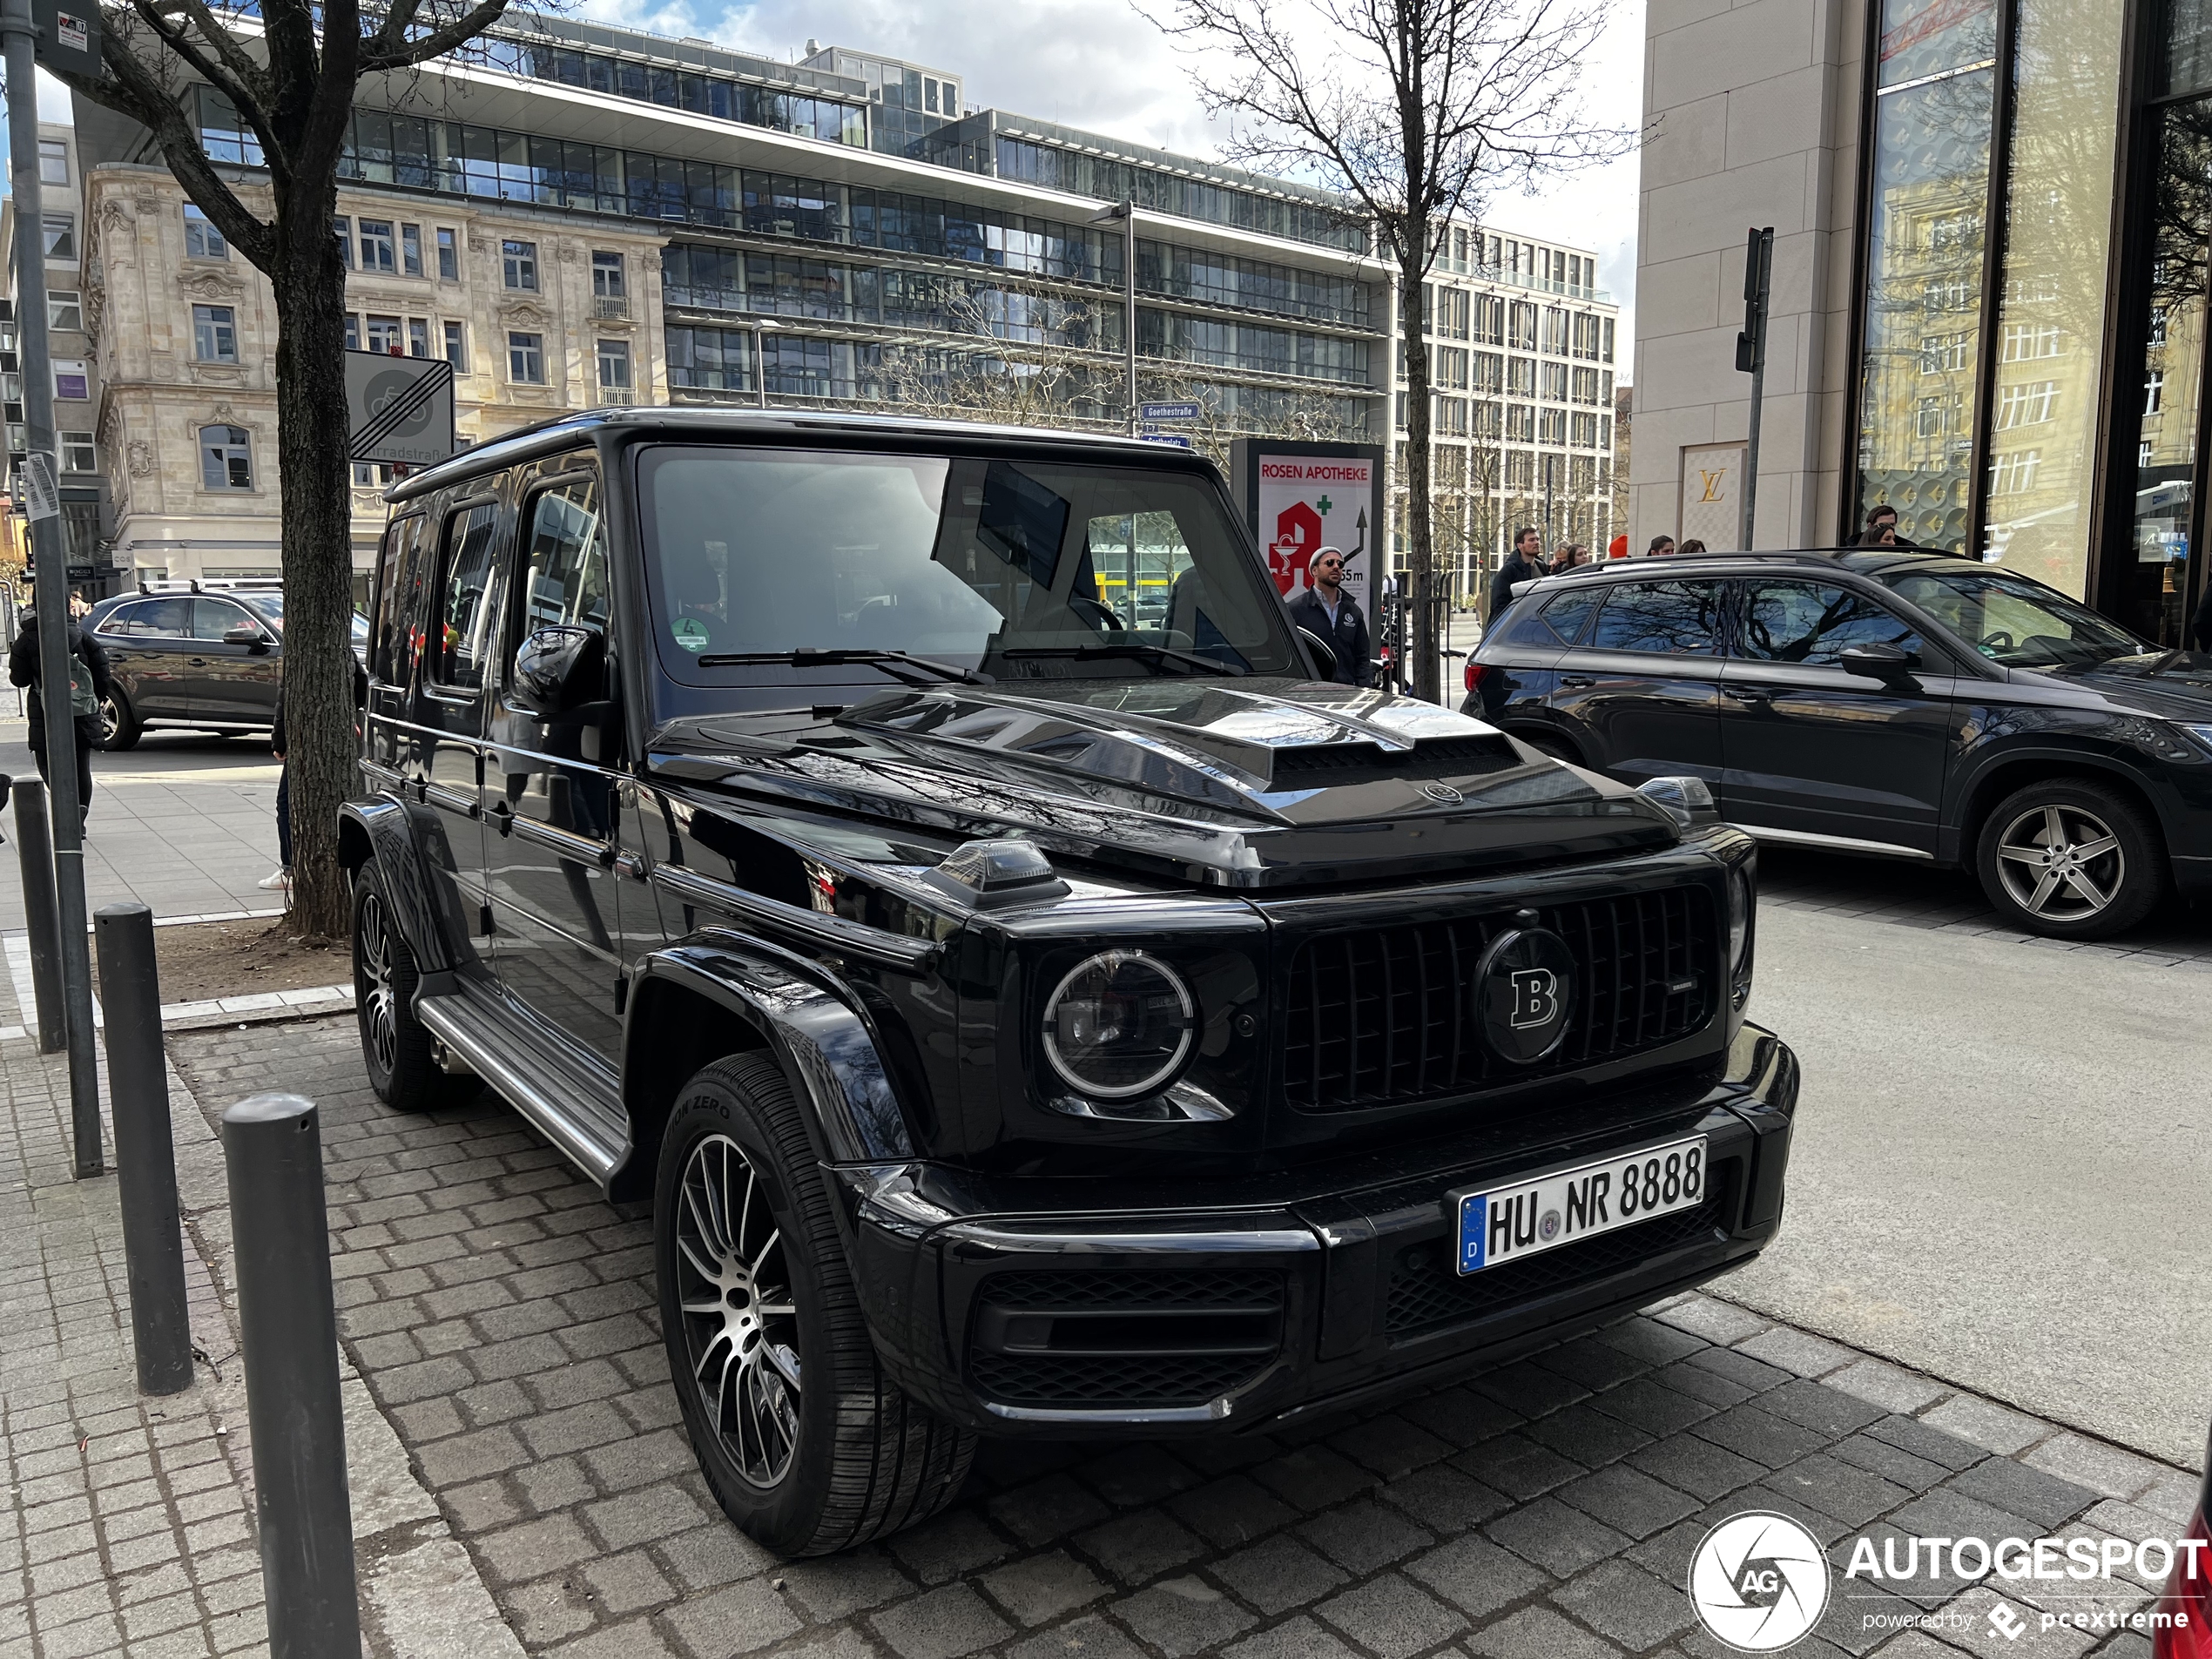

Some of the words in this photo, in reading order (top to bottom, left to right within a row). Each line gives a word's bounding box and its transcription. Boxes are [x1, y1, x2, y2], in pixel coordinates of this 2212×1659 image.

[1149, 406, 1192, 416] Goethestraße
[1262, 464, 1303, 479] ROSEN
[1306, 466, 1367, 481] APOTHEKE
[1353, 572, 1363, 582] m
[683, 619, 695, 636] 4
[1510, 968, 1558, 1030] B
[692, 1096, 731, 1120] ZERO
[1488, 1190, 1538, 1257] HU
[1565, 1171, 1611, 1234] NR
[1620, 1146, 1701, 1217] 8888
[1468, 1242, 1477, 1258] D
